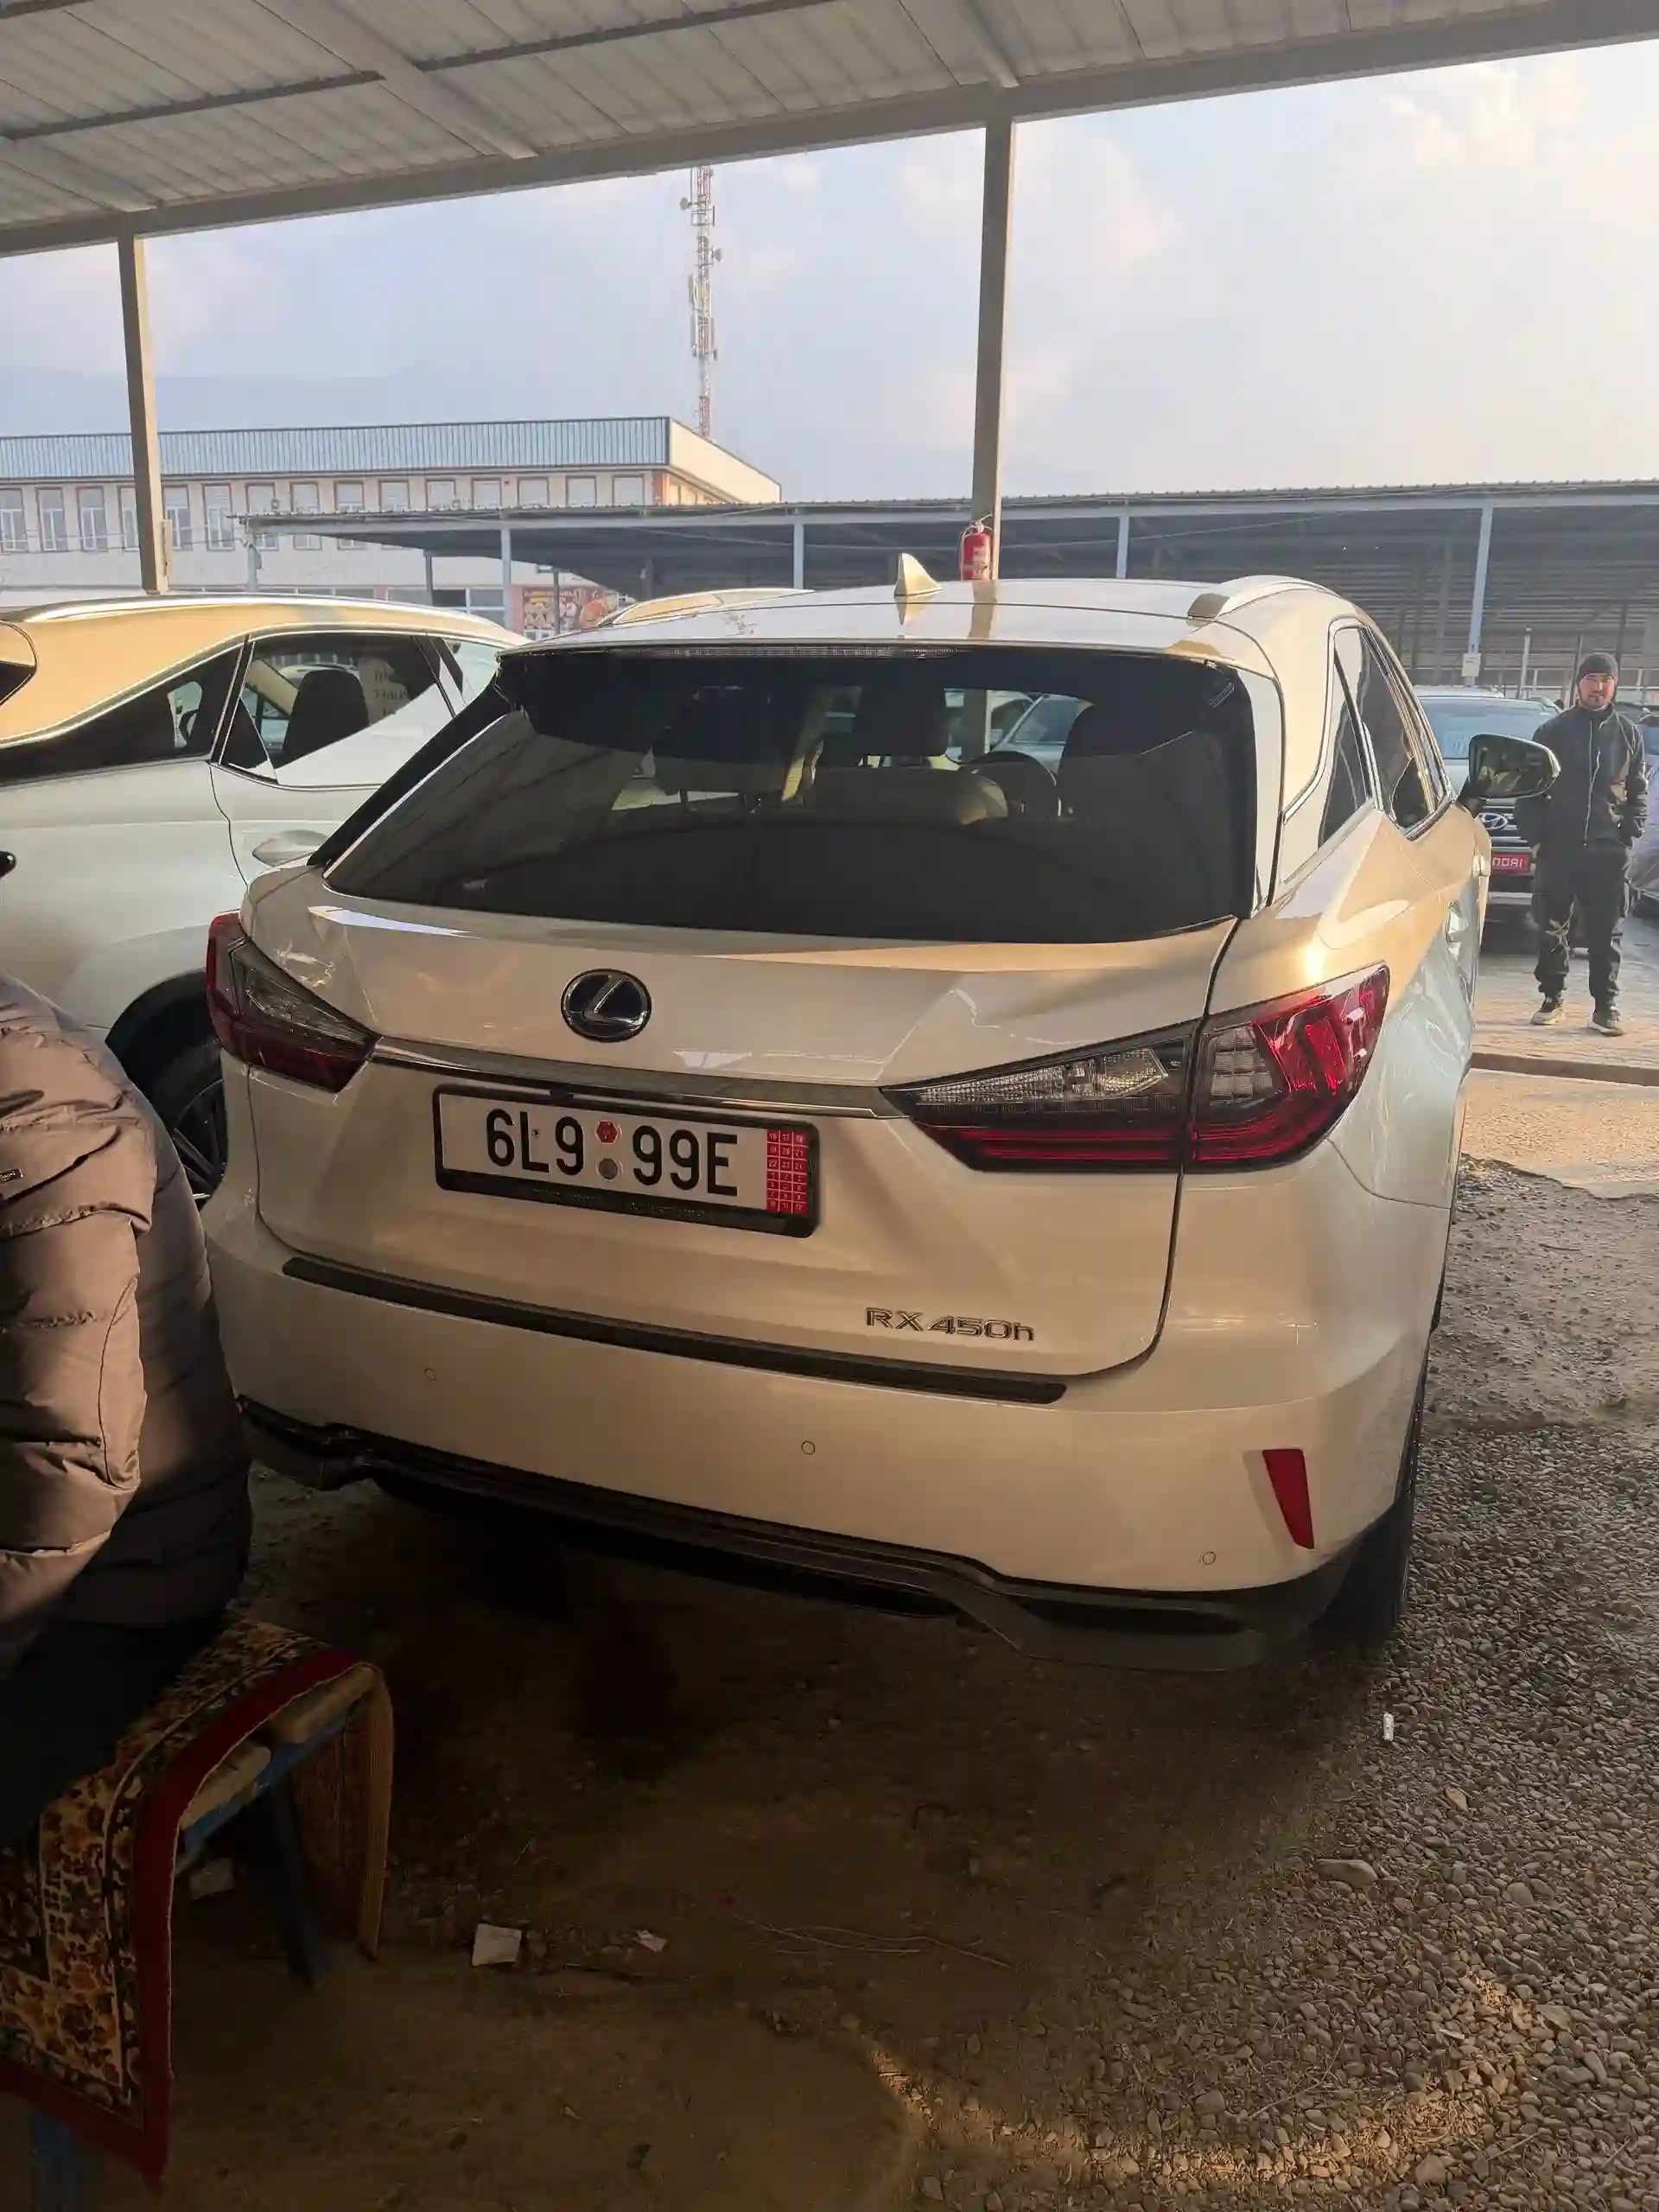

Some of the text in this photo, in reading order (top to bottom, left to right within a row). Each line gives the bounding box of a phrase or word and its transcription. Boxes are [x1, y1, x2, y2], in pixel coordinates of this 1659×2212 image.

[486, 1108, 738, 1197] 6L9 99E
[865, 1306, 1035, 1341] RX 450h
